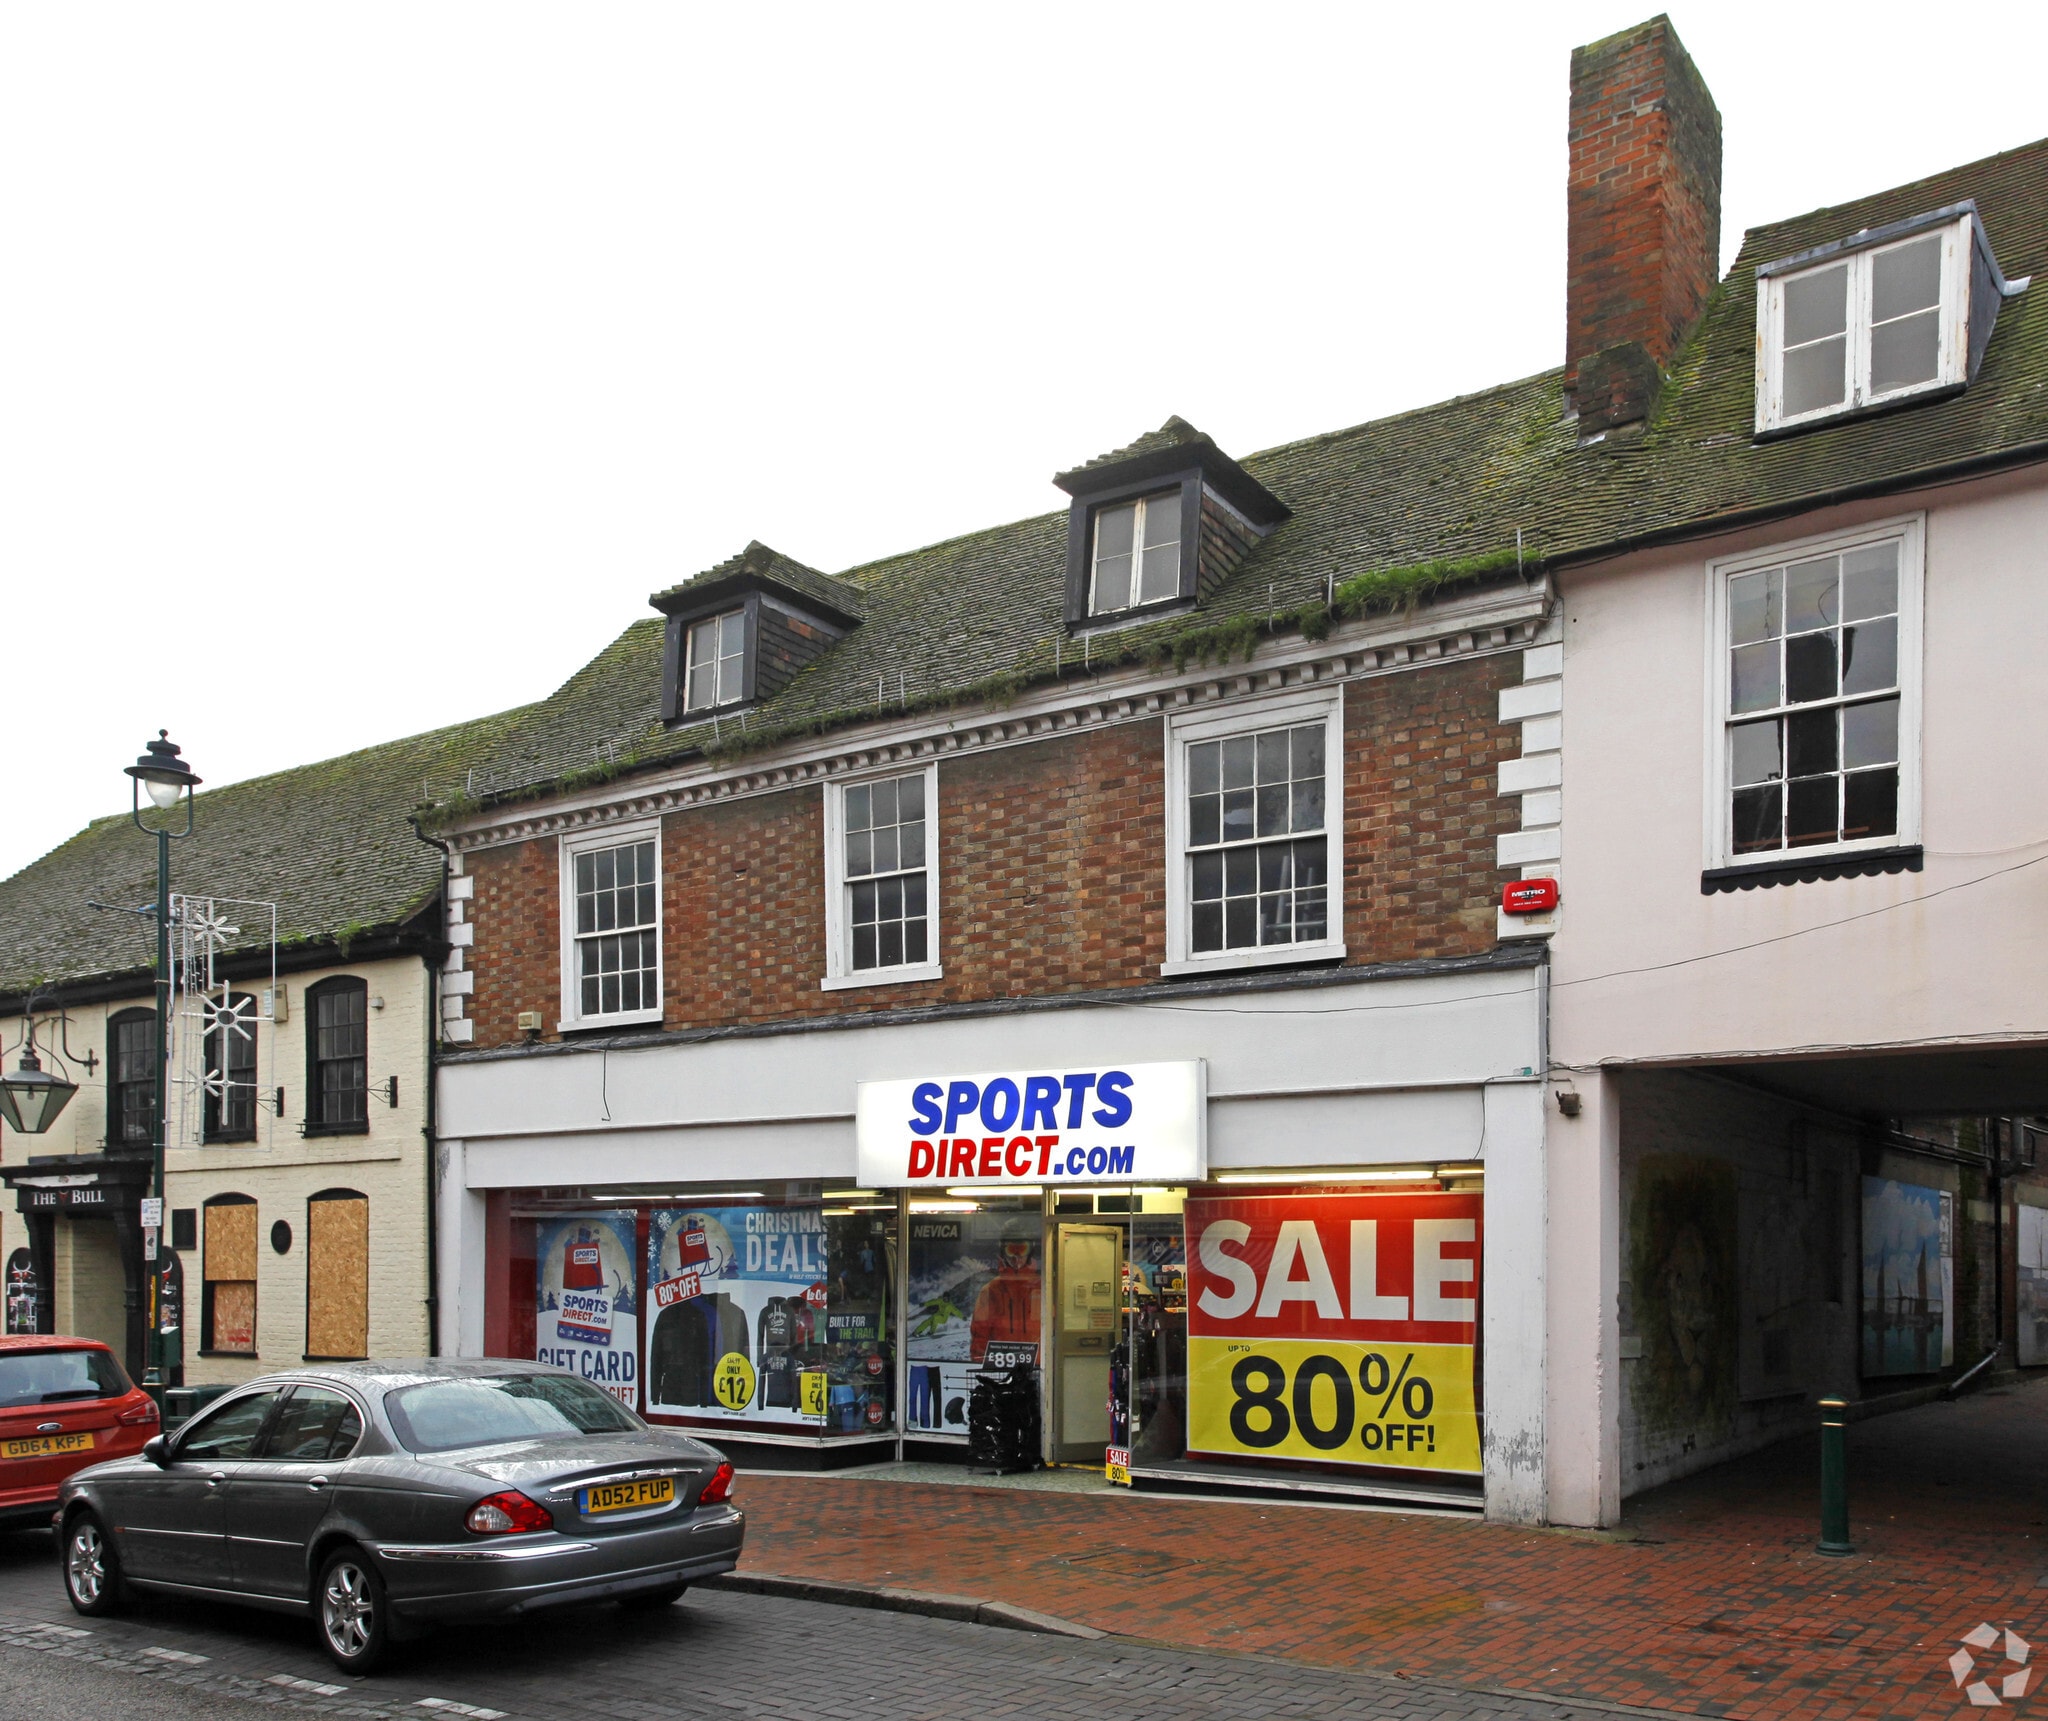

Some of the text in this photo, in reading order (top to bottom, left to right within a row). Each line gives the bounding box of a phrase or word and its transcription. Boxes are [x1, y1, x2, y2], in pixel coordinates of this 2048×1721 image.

[1511, 889, 1546, 897] METRO
[908, 1070, 1135, 1136] SPORTS
[32, 1189, 105, 1206] THE BULL
[913, 1224, 958, 1238] NEVICA
[574, 1249, 597, 1257] SPORTS
[746, 1234, 828, 1272] DEALS
[1196, 1218, 1476, 1322] SALE
[659, 1276, 698, 1304] 80% OFF
[563, 1294, 609, 1314] SPORTS
[829, 1315, 866, 1328] BUILT FOR
[840, 1327, 875, 1340] THE TRAIL
[581, 1349, 636, 1382] CARD
[988, 1351, 1032, 1368] £89.99
[726, 1366, 740, 1375] ONLY
[719, 1376, 746, 1404] £12
[809, 1390, 824, 1413] £6
[1229, 1353, 1434, 1450] 80%
[8, 1434, 86, 1455] GD64 KPF
[1361, 1422, 1436, 1453] OFF!
[1110, 1450, 1127, 1467] SALE
[591, 1480, 670, 1509] AD52 FUP
